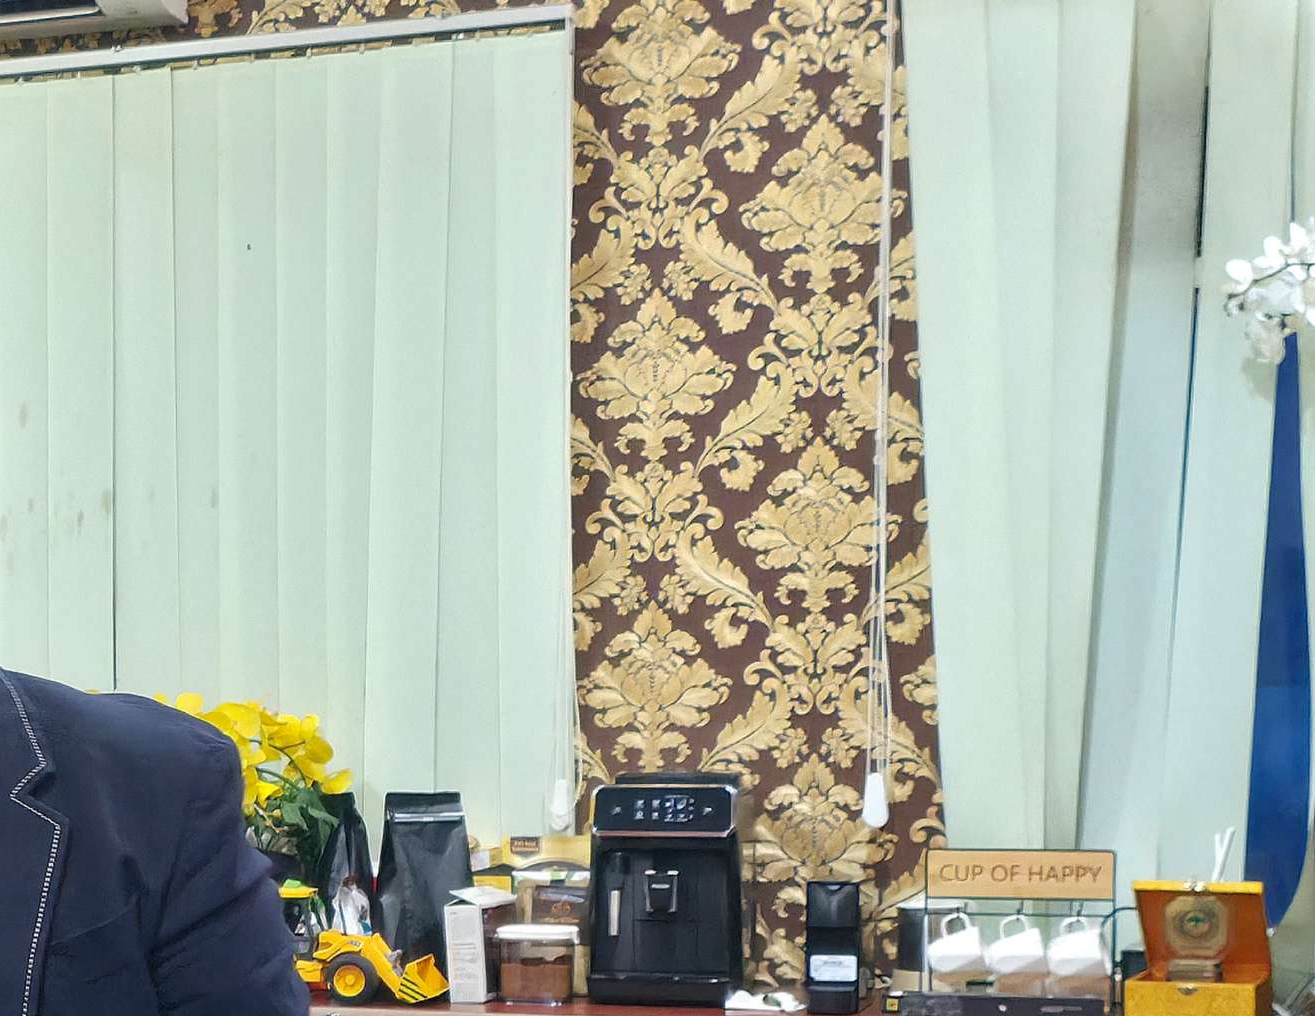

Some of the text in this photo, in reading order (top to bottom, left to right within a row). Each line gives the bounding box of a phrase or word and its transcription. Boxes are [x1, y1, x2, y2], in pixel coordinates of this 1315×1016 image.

[939, 864, 1103, 883] CUP OF HAPPY
